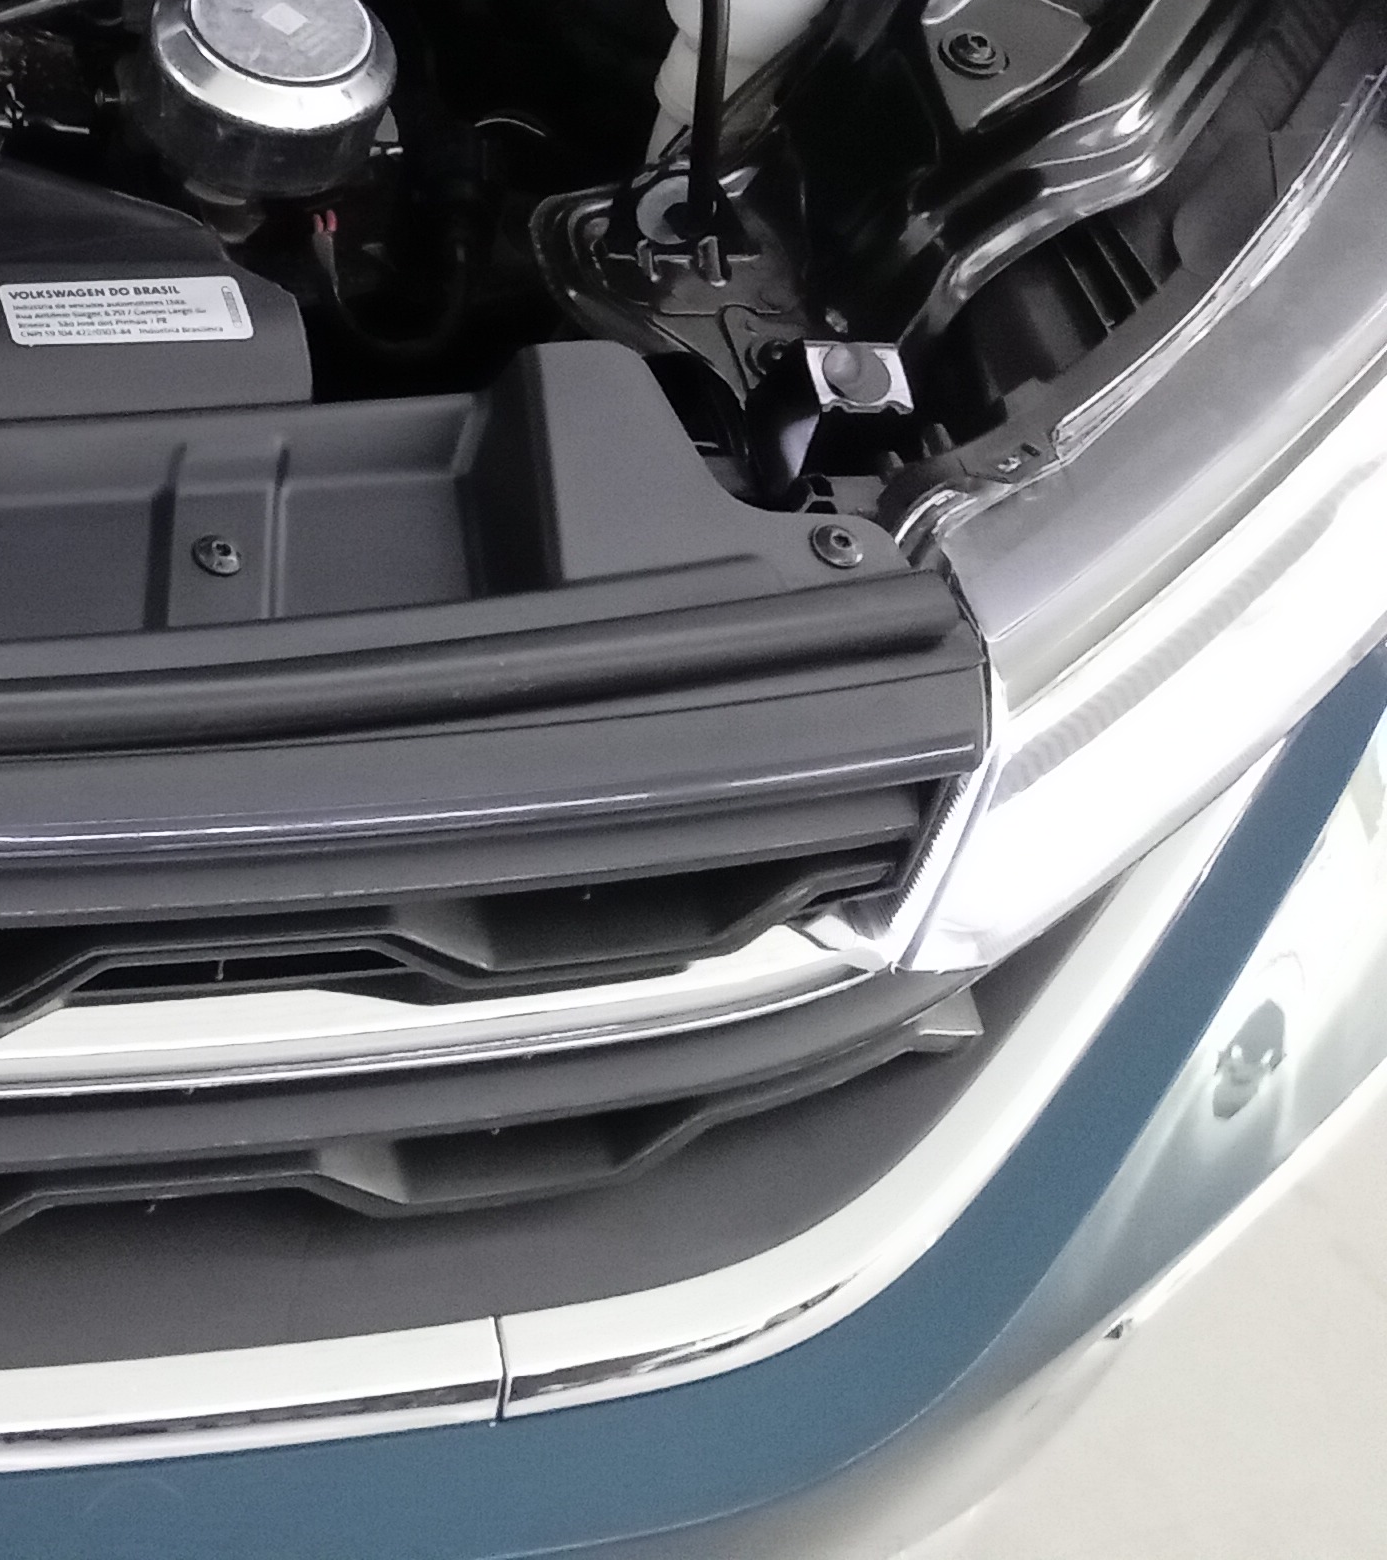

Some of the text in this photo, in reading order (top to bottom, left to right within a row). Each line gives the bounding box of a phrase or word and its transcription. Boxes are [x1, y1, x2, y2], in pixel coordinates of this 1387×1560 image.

[8, 285, 181, 300] VOLKSWAGEN DO BRASIL
